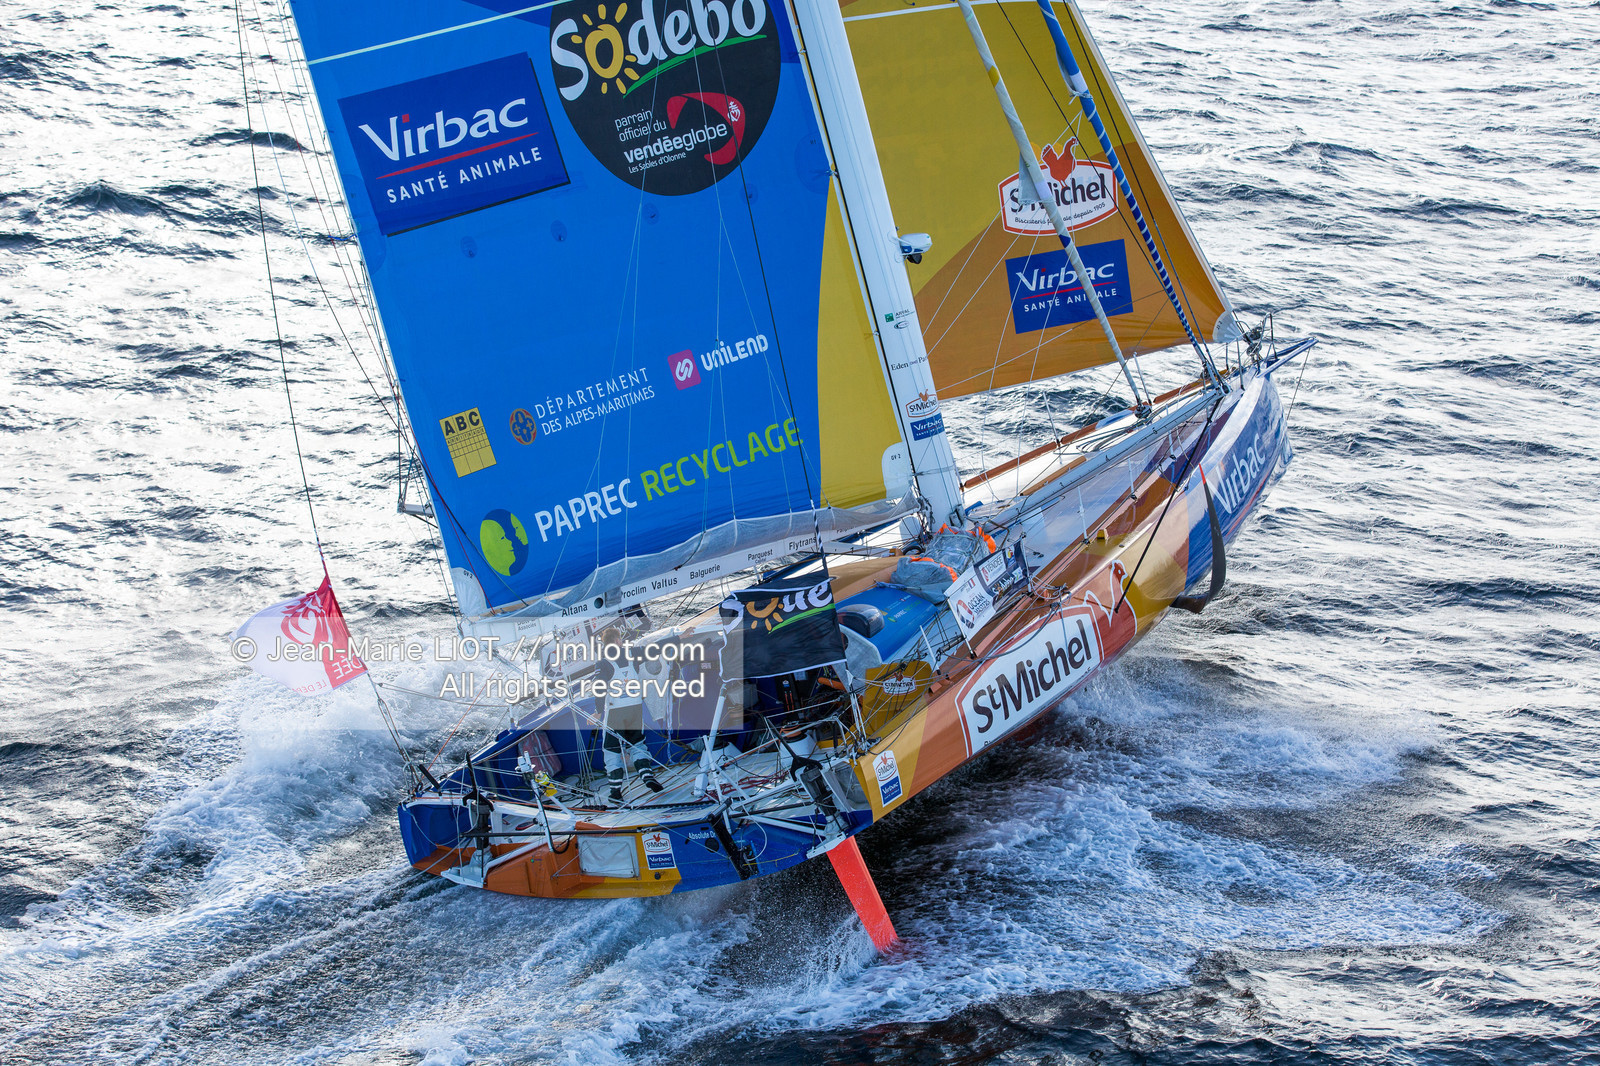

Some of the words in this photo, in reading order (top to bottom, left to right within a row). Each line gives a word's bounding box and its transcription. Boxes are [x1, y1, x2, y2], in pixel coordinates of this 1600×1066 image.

[551, 0, 767, 101] Sodebo
[358, 97, 529, 162] Virbac
[614, 109, 653, 132] parrain
[618, 122, 652, 142] officiel
[653, 119, 667, 133] du
[386, 174, 449, 204] SANTÉ
[459, 146, 543, 185] ANIMALE
[628, 165, 639, 174] Les
[639, 160, 658, 172] Sables
[1016, 263, 1115, 292] Virbac
[1023, 297, 1061, 313] SANTÉ
[1066, 288, 1118, 305] ANIALE
[890, 362, 909, 371] Eden
[534, 367, 649, 419] DÉPARTEMENT
[541, 418, 562, 436] DES
[565, 385, 656, 429] ALPES-MARITIMES
[444, 411, 480, 437] ABC
[640, 416, 804, 502] RECYCLAGE
[1203, 433, 1266, 515] Virbac
[534, 478, 638, 543] PAPREC
[788, 536, 817, 551] Flytrans
[650, 576, 678, 591] Valtus
[689, 563, 721, 580] Balguerie
[620, 584, 647, 599] roclim
[561, 603, 588, 618] Altana
[688, 831, 710, 840] Absolute
